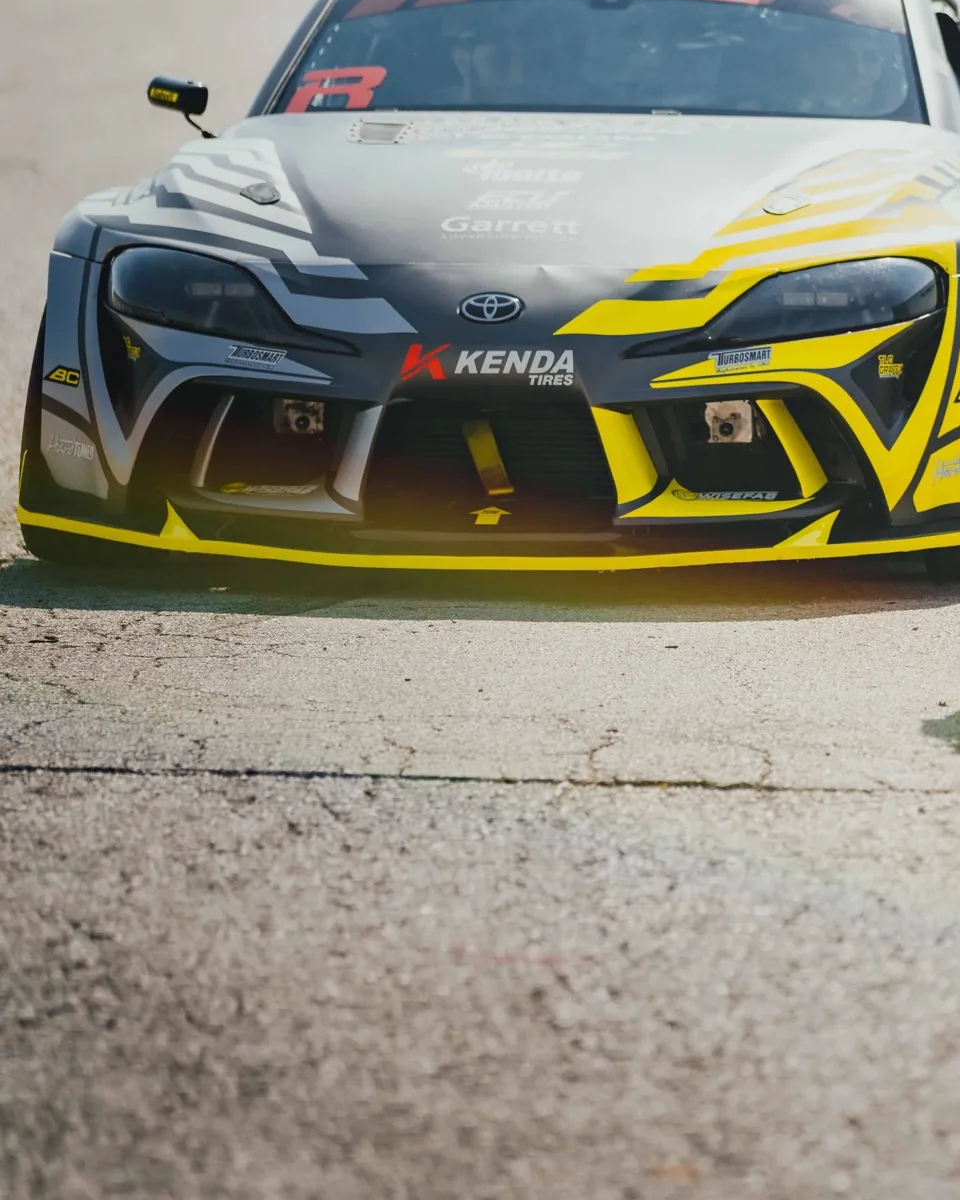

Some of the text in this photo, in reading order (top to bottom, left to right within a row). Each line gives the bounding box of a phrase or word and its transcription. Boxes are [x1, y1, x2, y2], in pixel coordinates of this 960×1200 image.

[440, 216, 580, 235] Garrett
[454, 350, 574, 374] KENDA
[711, 347, 771, 366] TURBOSMART
[528, 374, 574, 386] TIRES
